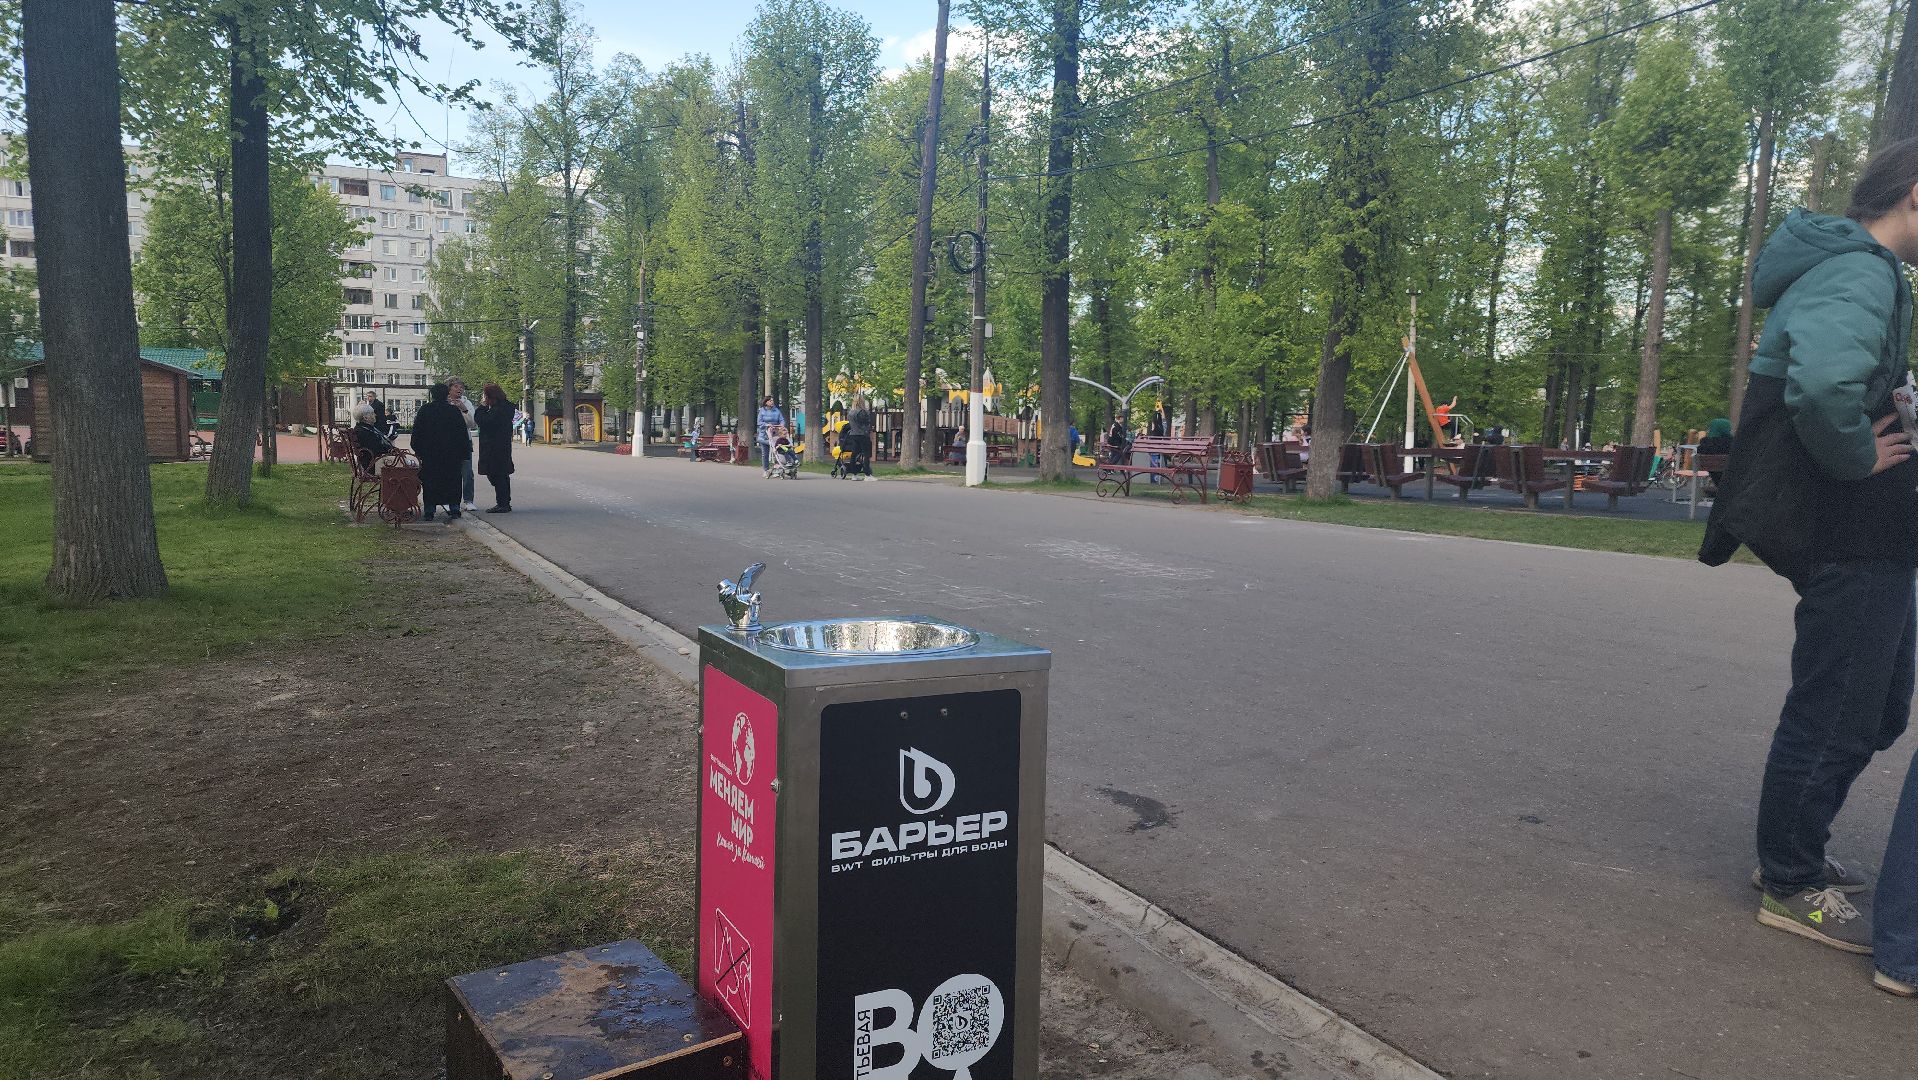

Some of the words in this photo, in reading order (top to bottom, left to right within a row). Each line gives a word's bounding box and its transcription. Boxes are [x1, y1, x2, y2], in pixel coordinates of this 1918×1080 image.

[709, 764, 754, 825] МЕНЯЕМ
[731, 810, 754, 848] МИР
[831, 810, 1008, 860] БАРЬЕР
[831, 860, 864, 873] BWT
[871, 849, 938, 867] ФИЛЬТРЫ
[941, 844, 968, 857] ДЛЯ
[971, 839, 1008, 852] ВОДЫ
